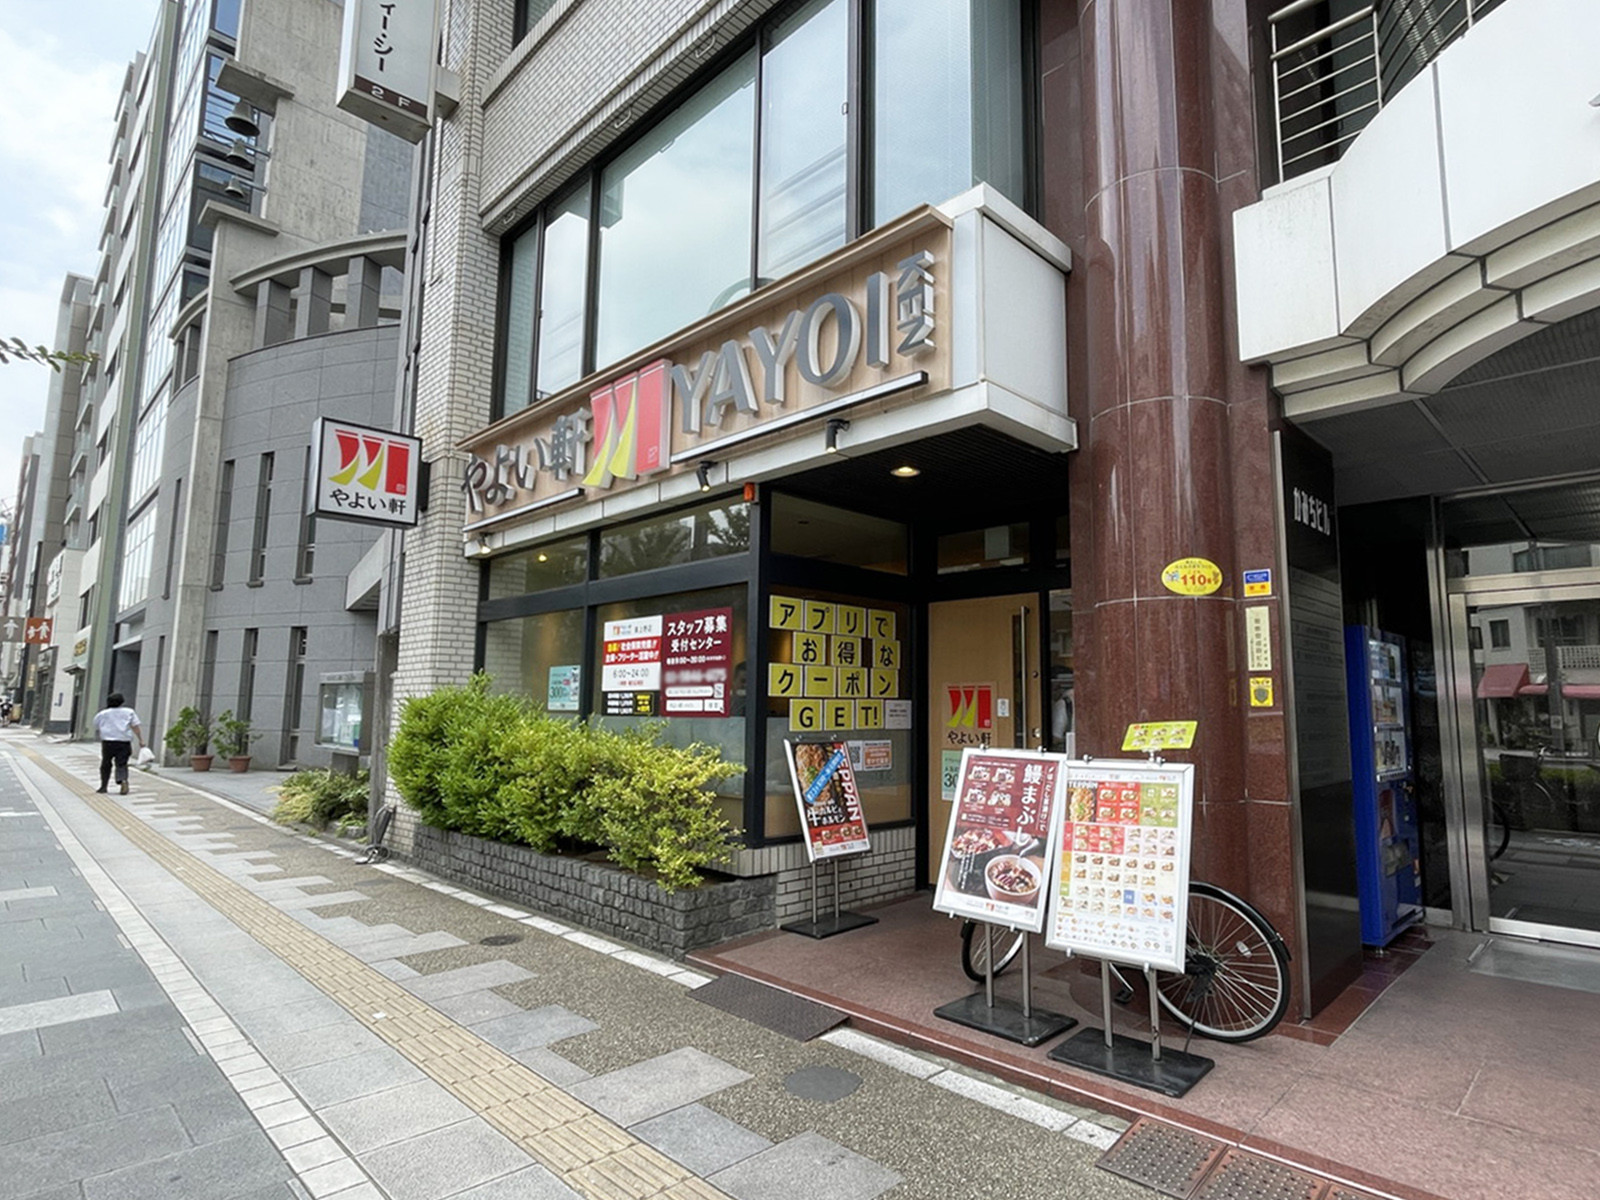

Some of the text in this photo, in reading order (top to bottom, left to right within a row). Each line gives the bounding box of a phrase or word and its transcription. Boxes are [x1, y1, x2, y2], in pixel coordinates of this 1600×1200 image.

[896, 250, 935, 357] KEN
[672, 271, 890, 435] YAYOI
[461, 407, 592, 513] やよい軒
[329, 488, 407, 515] やよい軒
[667, 615, 727, 636] スタッフ募集
[779, 603, 889, 638] アプリで
[670, 637, 722, 653] 受付センター
[801, 638, 894, 667] お得な
[778, 669, 891, 695] クーポン
[799, 706, 878, 729] GET!
[947, 730, 992, 745] やよい軒
[1015, 763, 1043, 847] 鰻まぶし
